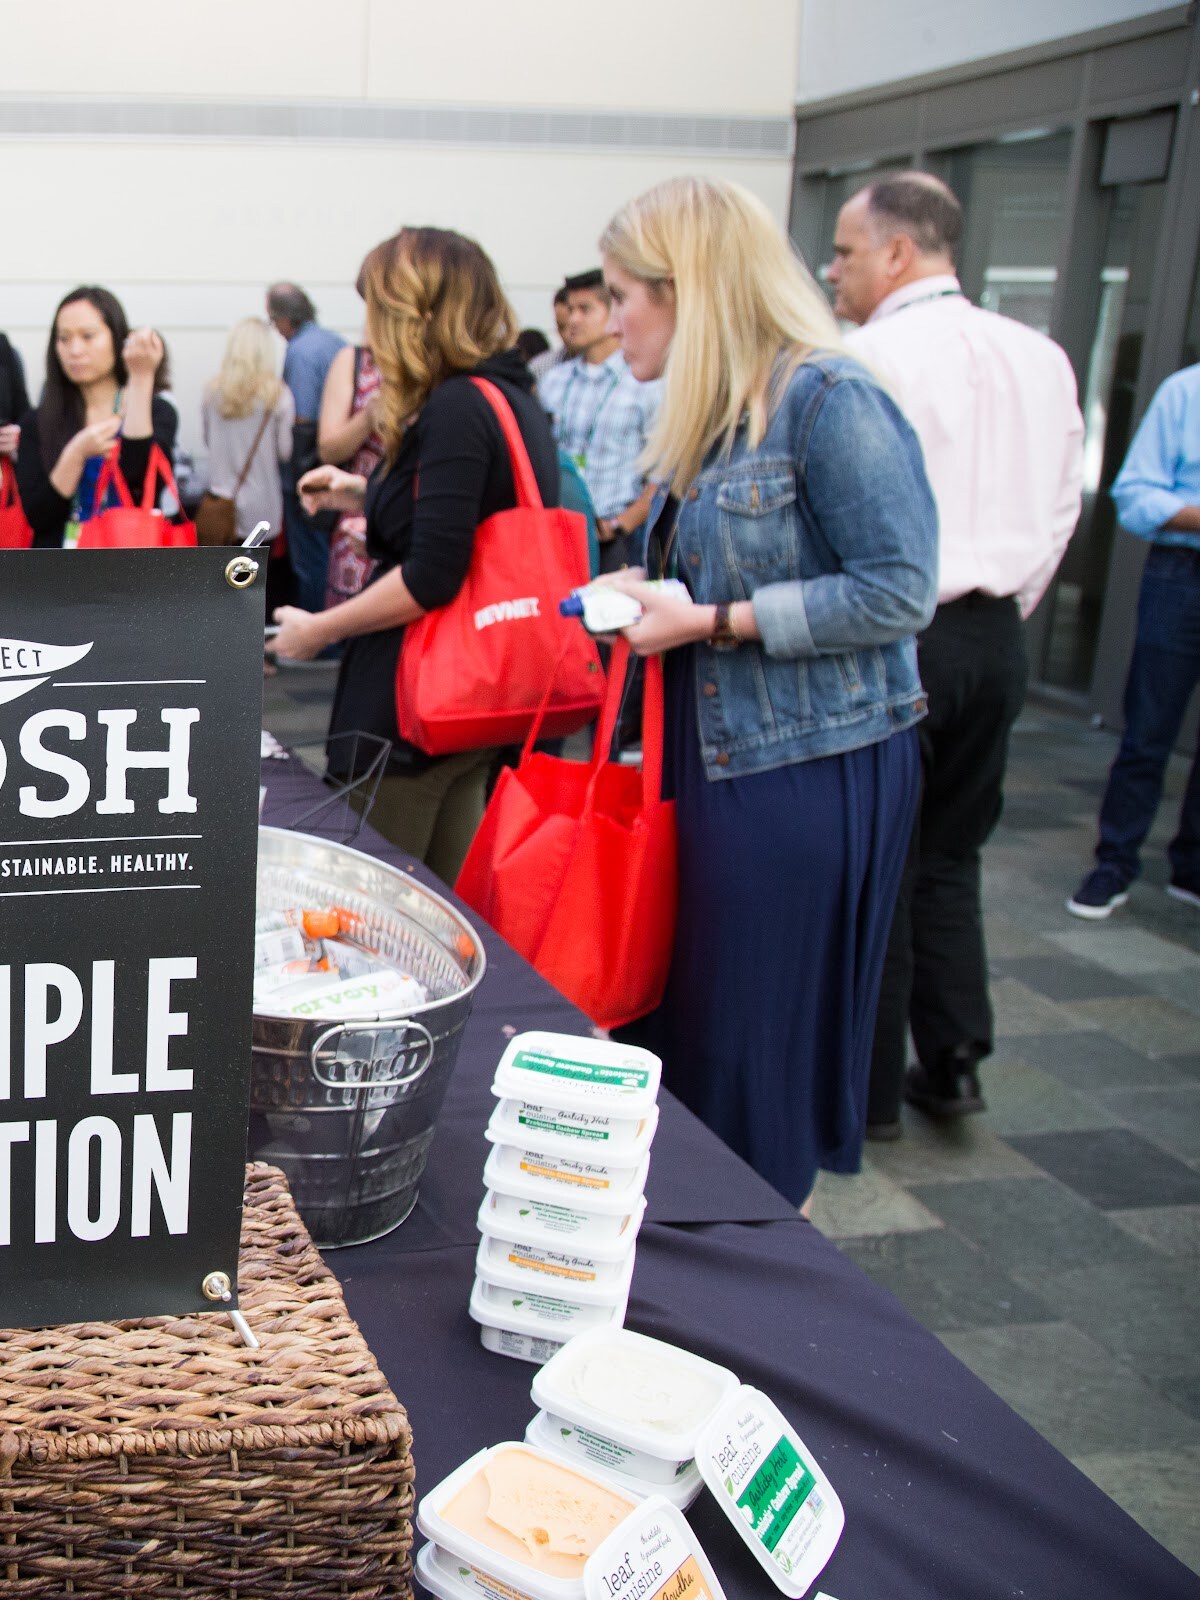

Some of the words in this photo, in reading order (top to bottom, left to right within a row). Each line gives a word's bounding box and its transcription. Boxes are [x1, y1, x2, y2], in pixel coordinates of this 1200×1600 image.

[110, 853, 194, 873] HEALTHY.
[525, 1118, 555, 1129] Probiotic
[555, 1124, 580, 1134] Cashew
[581, 1129, 605, 1139] Spread
[558, 1111, 589, 1125] Garlicky
[590, 1116, 610, 1126] Herb
[560, 1159, 583, 1173] Smoky
[547, 1252, 570, 1265] Smoky
[712, 1435, 738, 1473] leaf
[731, 1443, 761, 1485] cuisine
[748, 1470, 779, 1511] Garlicky
[769, 1446, 788, 1476] Herb
[770, 1483, 791, 1512] Cashew
[785, 1462, 805, 1491] Spread
[602, 1552, 635, 1598] leaf
